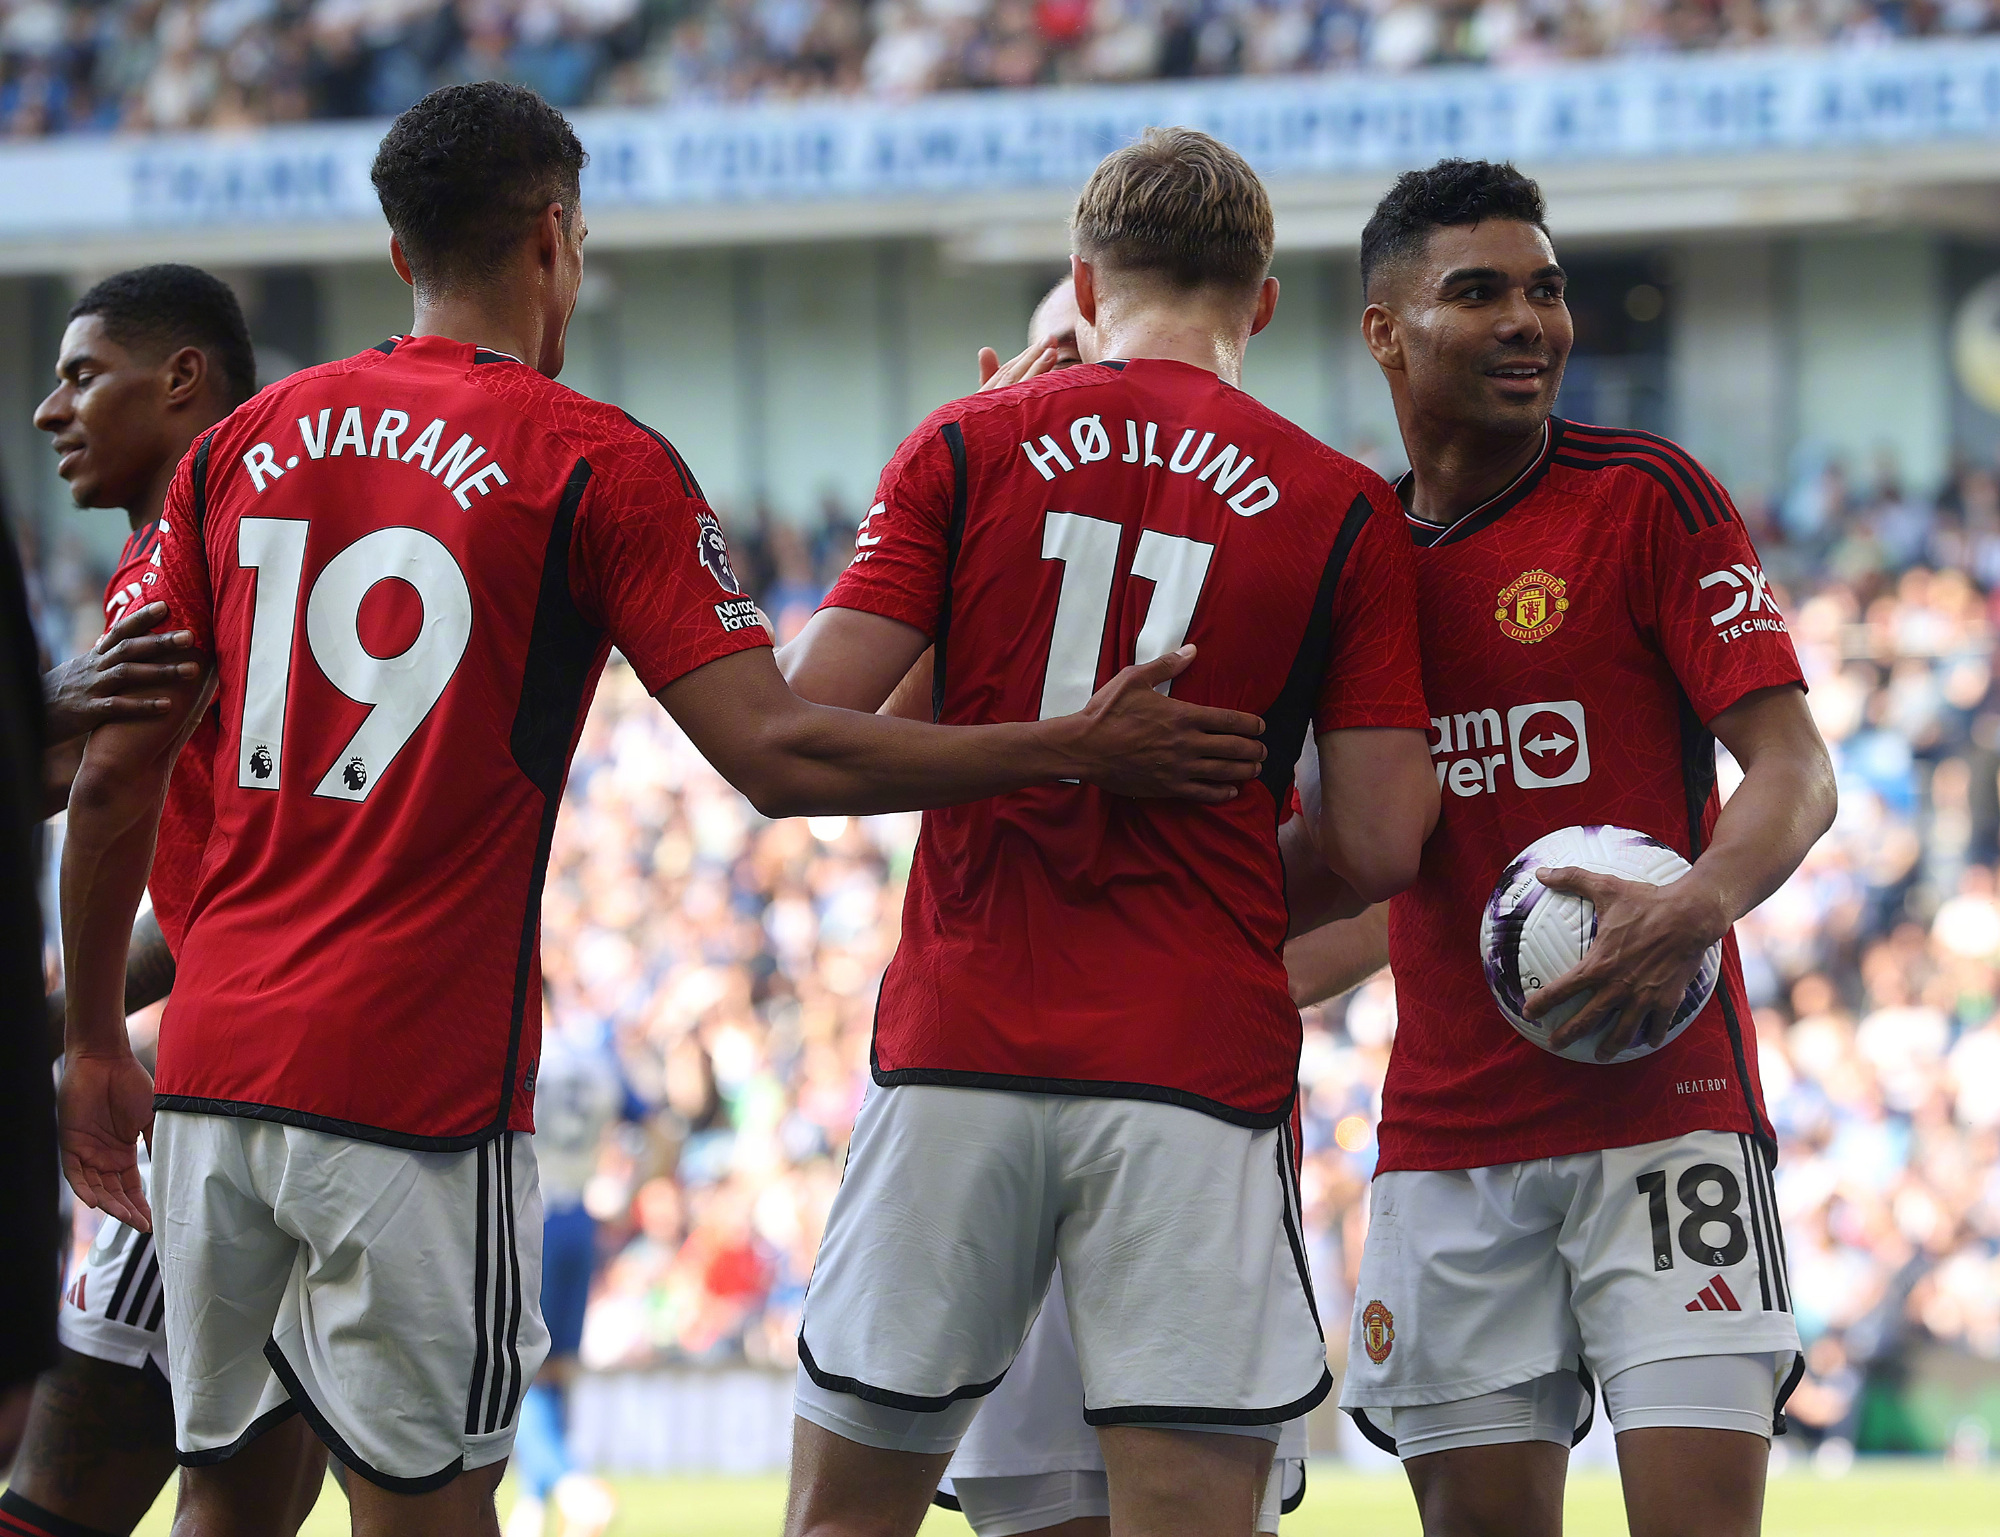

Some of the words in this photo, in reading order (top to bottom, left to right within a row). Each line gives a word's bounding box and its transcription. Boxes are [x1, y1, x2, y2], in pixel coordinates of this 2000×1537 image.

[242, 406, 509, 512] R.VARANE
[1021, 413, 1280, 517] HØJLUND
[714, 601, 738, 620] No
[1503, 574, 1561, 602] MANCHESTER
[721, 615, 743, 632] For
[1038, 510, 1215, 784] 11
[1511, 623, 1553, 639] UNITED
[238, 516, 473, 803] 19
[1430, 708, 1504, 755] am
[1676, 1078, 1728, 1095] HEAT.RDY
[1636, 1163, 1749, 1272] 18
